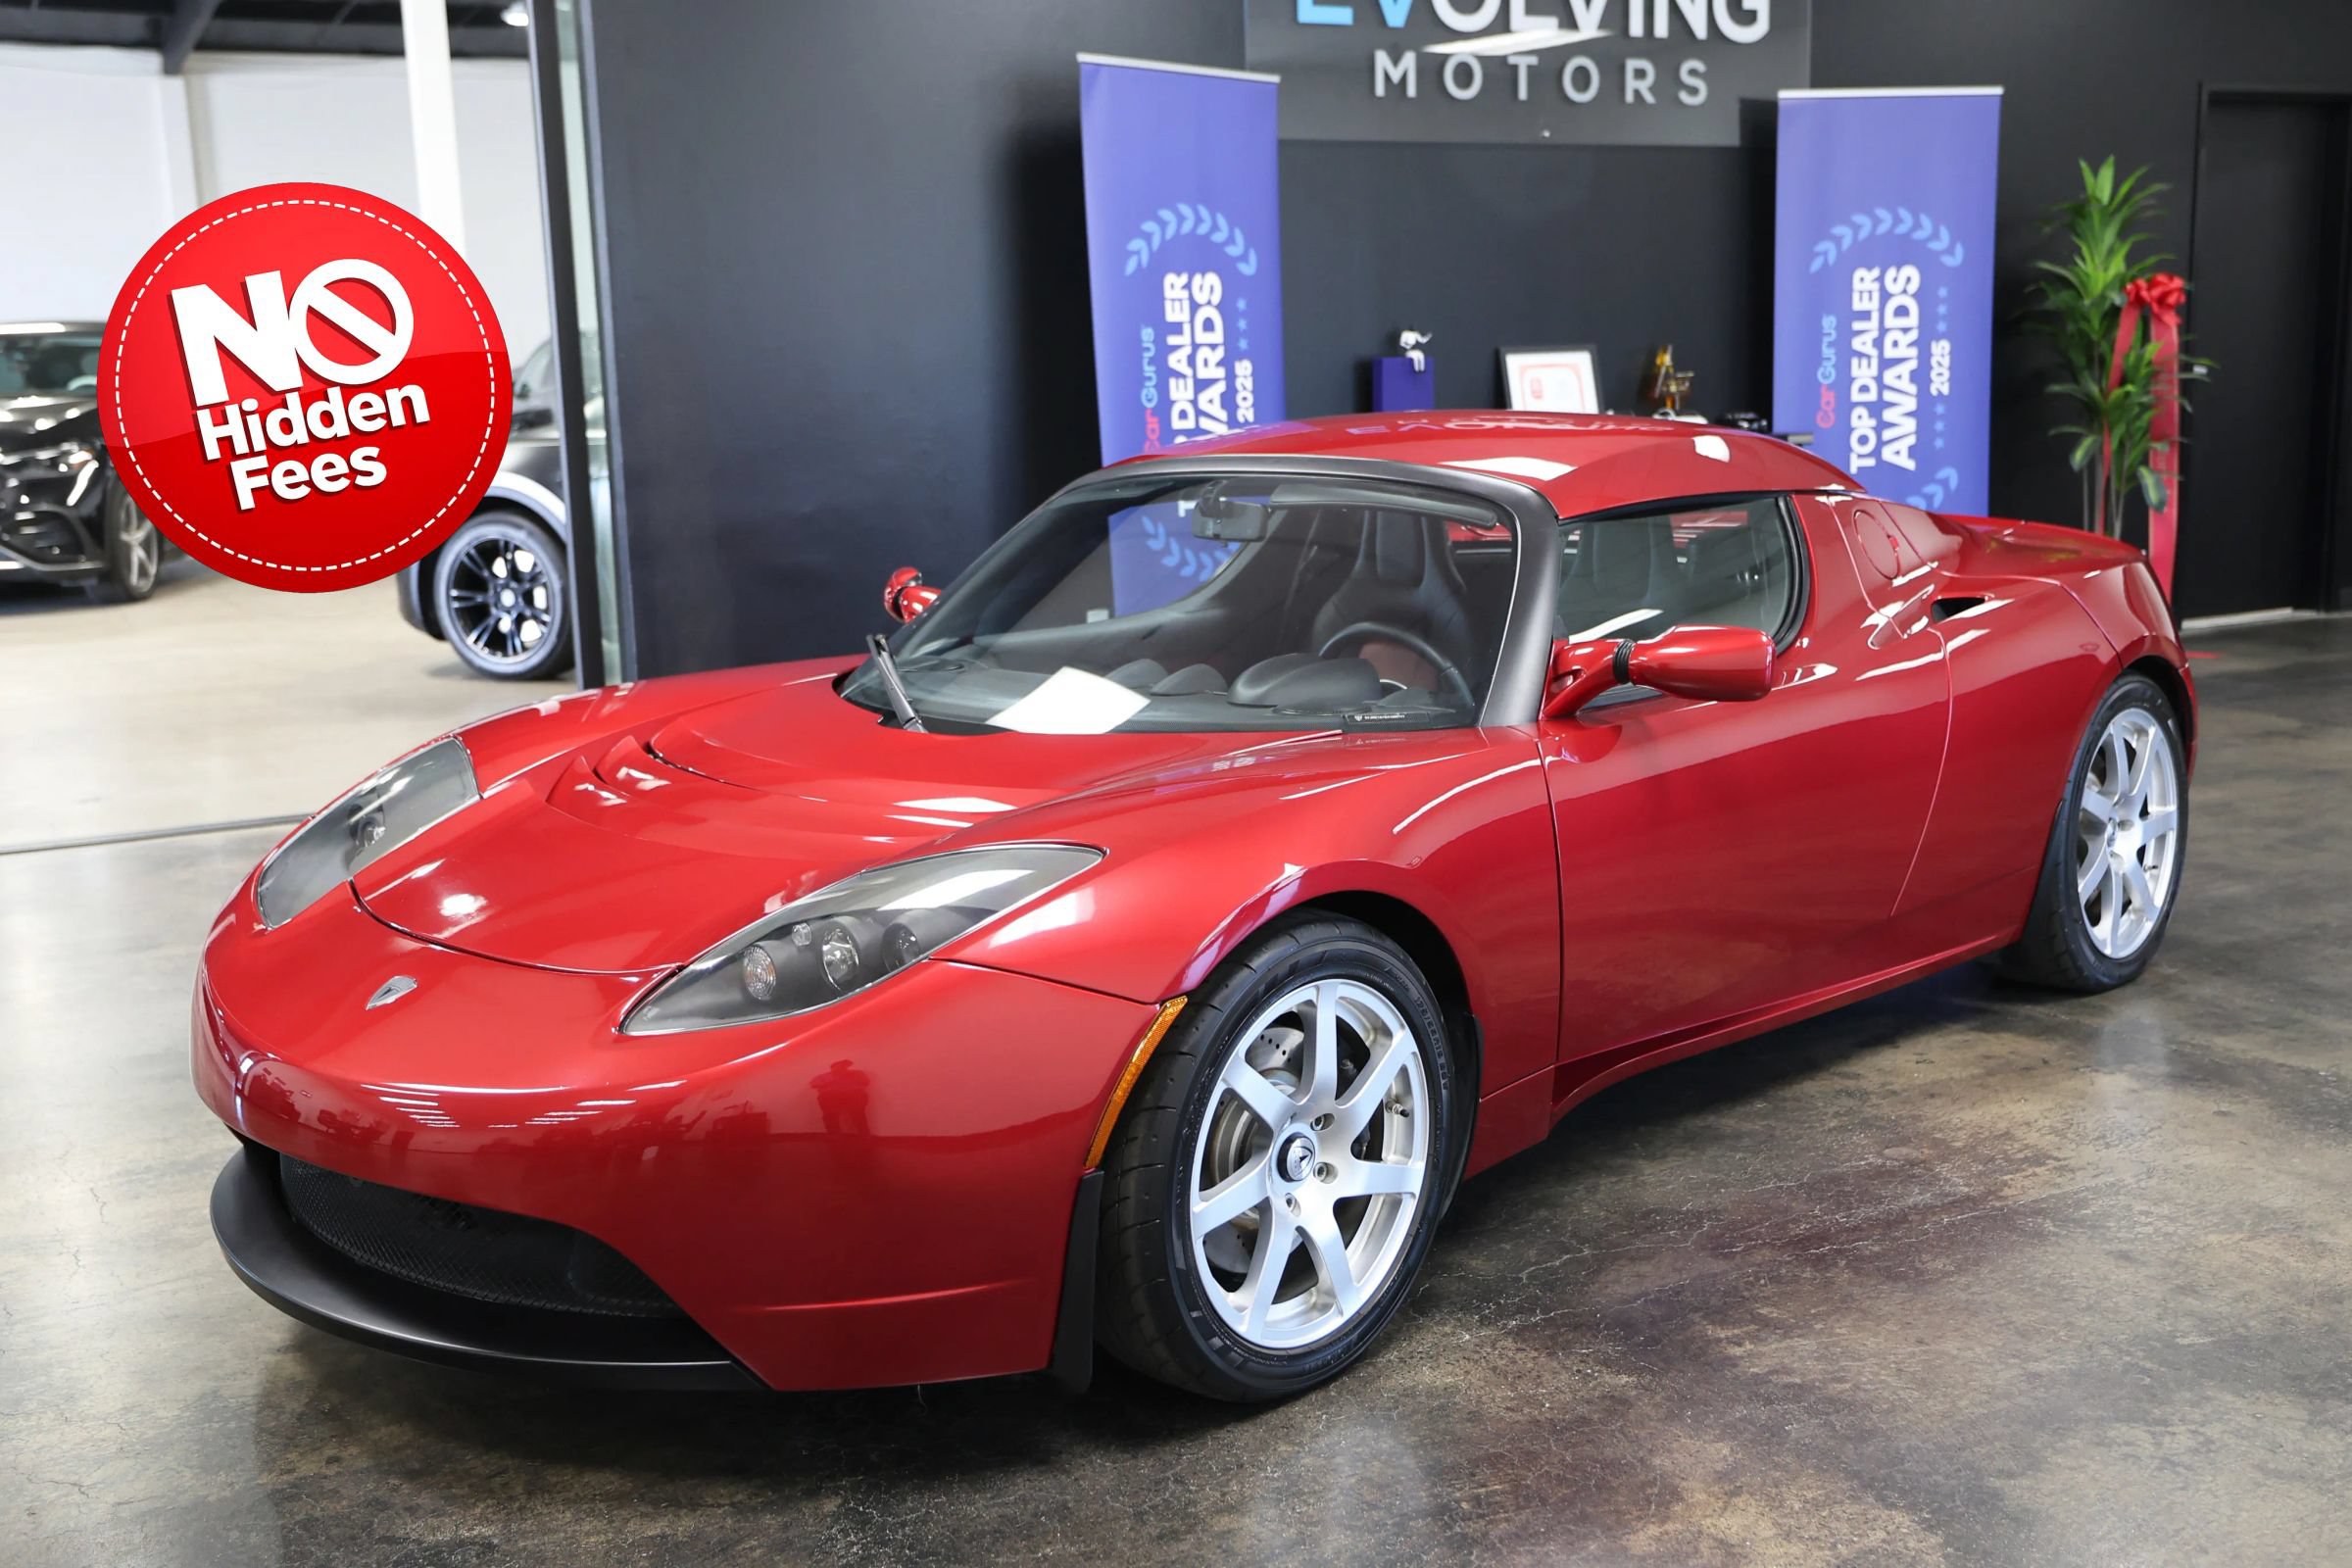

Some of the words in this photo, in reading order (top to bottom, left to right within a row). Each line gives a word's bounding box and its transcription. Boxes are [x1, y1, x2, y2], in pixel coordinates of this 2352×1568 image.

[1374, 49, 1708, 106] MOTORS
[1141, 325, 1160, 449] arGurus
[1163, 271, 1196, 429] DEALER
[1235, 359, 1254, 422] 2025
[1816, 314, 1837, 429] CarGurus
[1850, 267, 1881, 403] DEALER
[1882, 264, 1922, 471] AWARDS
[1930, 339, 1951, 397] 2025
[1850, 406, 1877, 474] TOP
